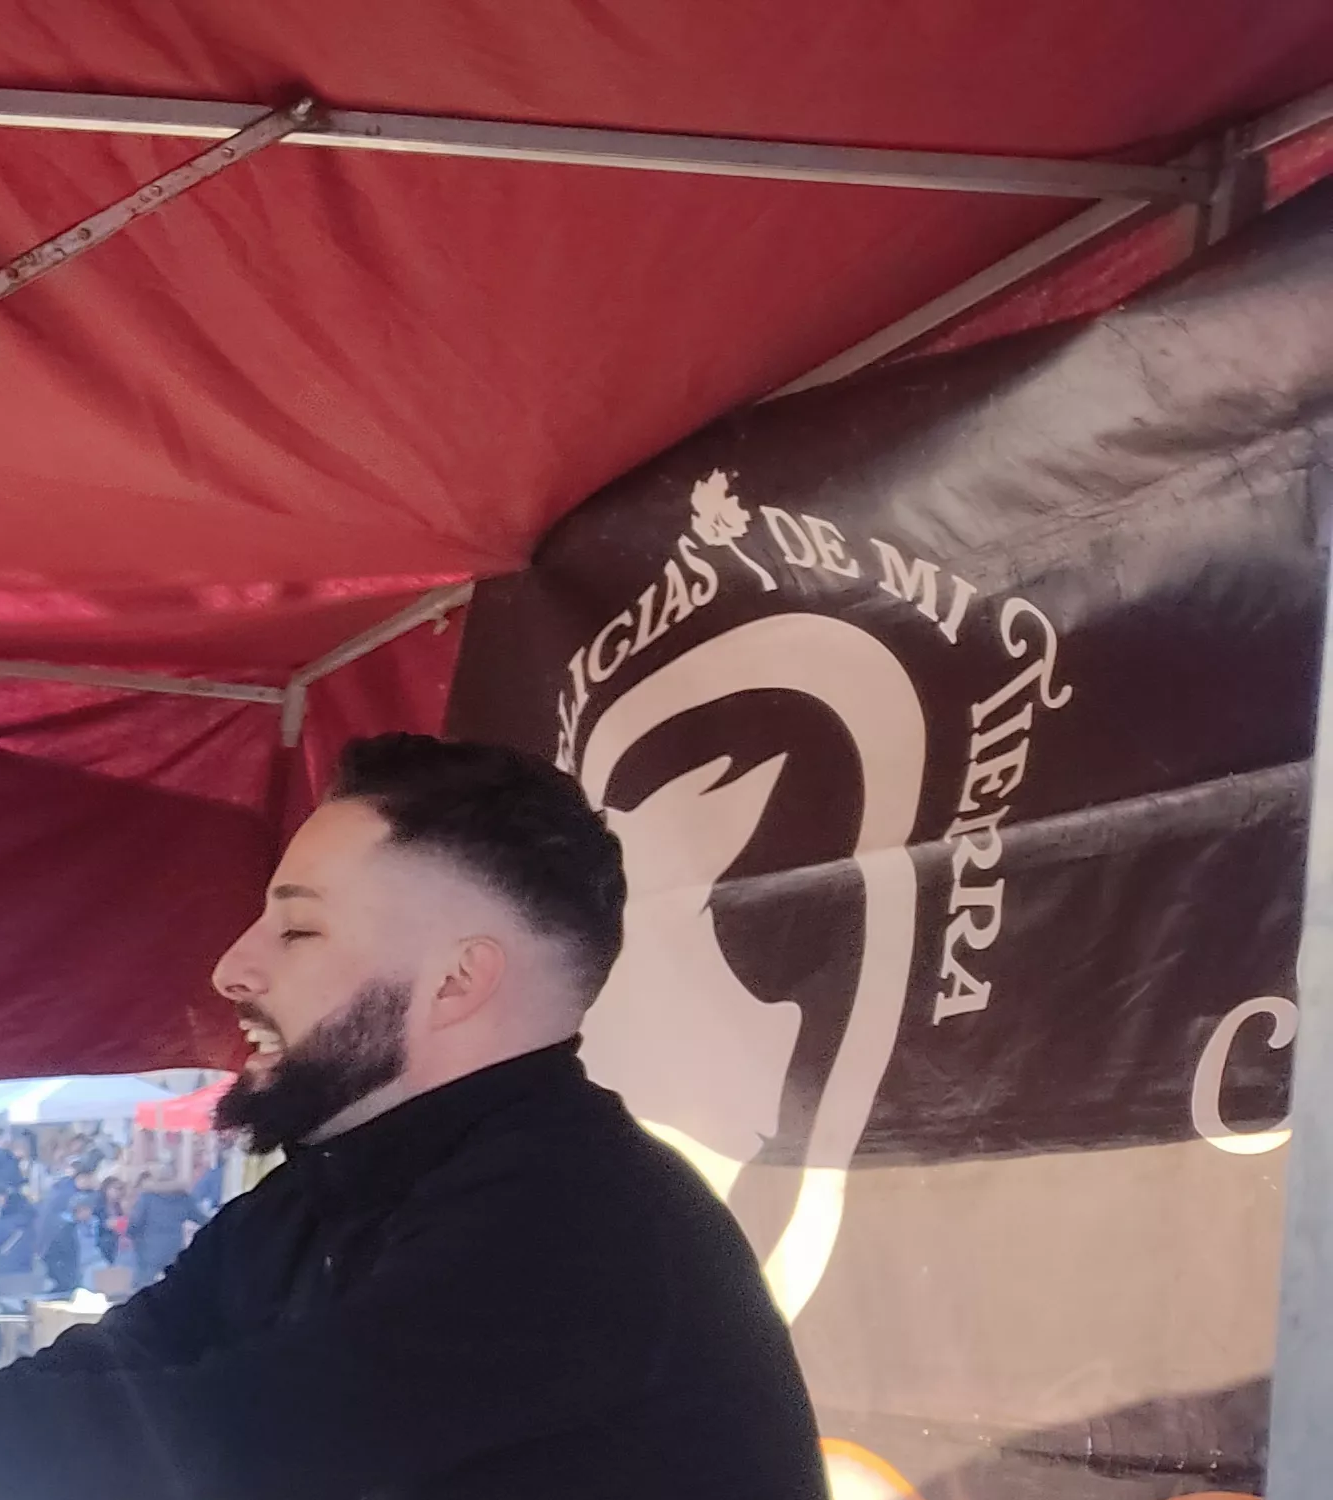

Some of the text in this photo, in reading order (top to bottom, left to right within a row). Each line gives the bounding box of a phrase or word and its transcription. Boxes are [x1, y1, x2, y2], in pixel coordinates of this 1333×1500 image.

[554, 505, 1073, 1027] ELICIAS DE MI TIERRA
